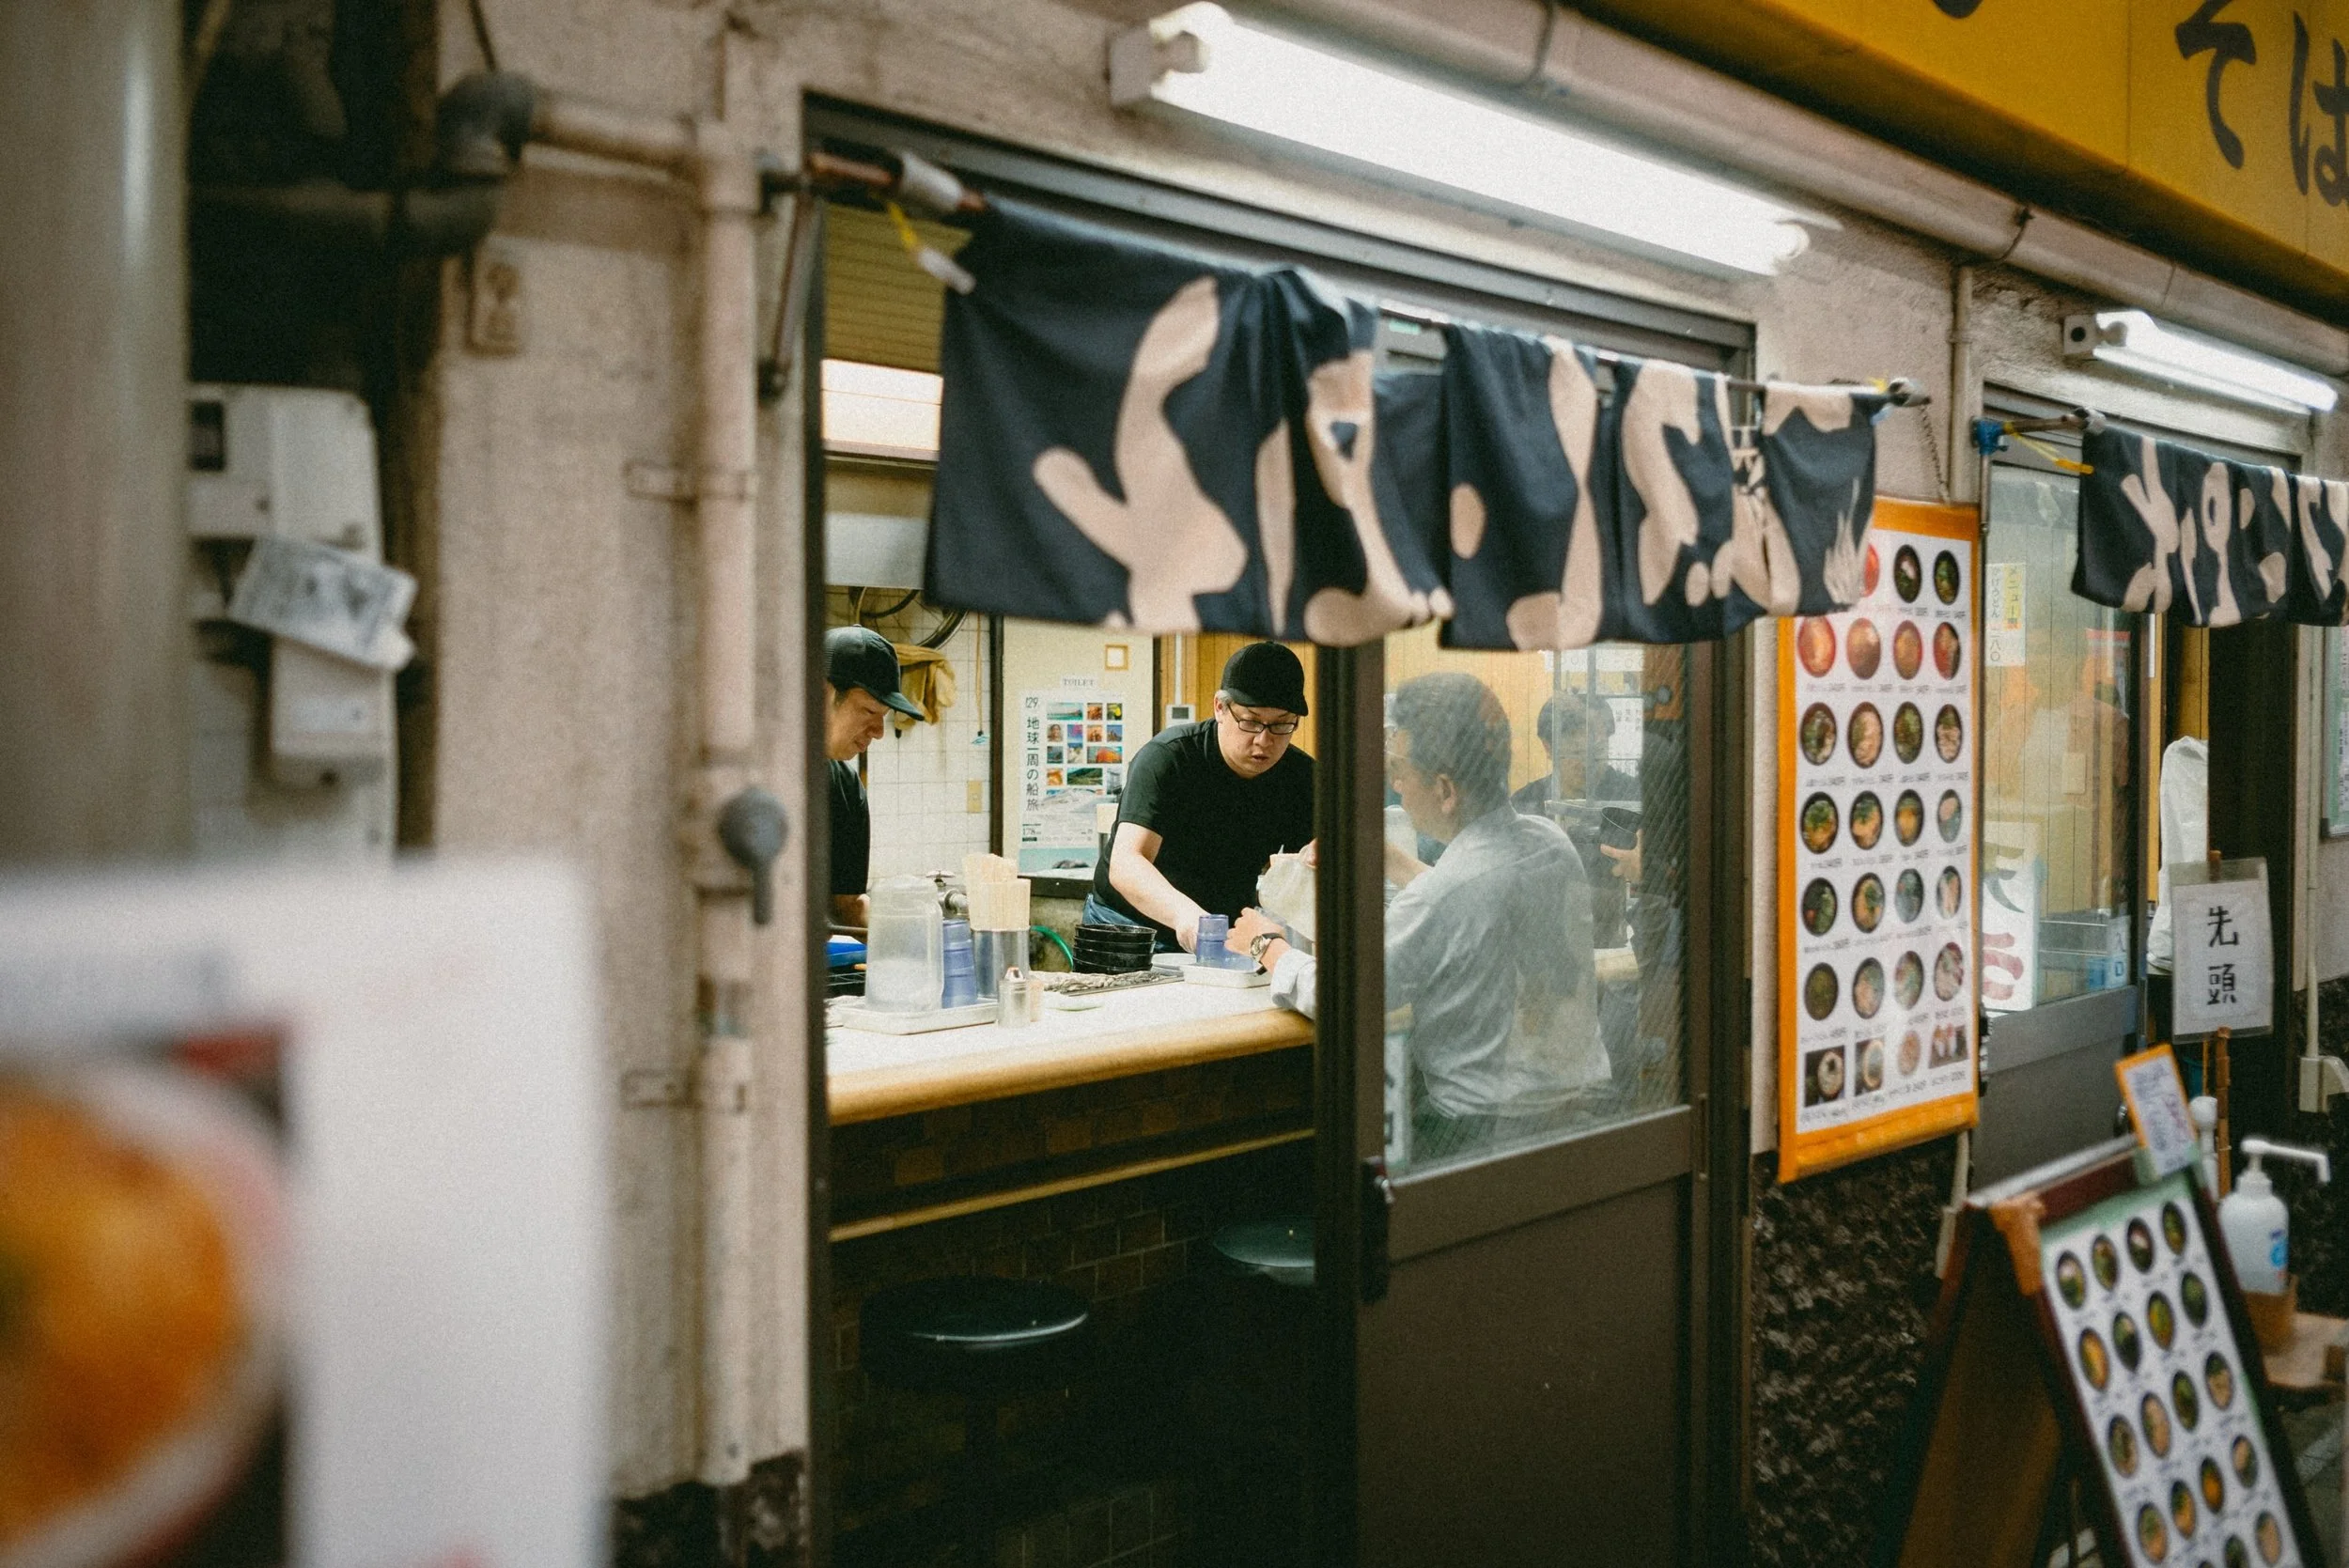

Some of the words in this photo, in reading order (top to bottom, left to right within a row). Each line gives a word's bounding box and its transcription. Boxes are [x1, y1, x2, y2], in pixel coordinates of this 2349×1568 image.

[1063, 678, 1096, 687] TOILET
[1026, 716, 1040, 811] 地球一周の船旅
[2206, 905, 2240, 1005] 先頭
